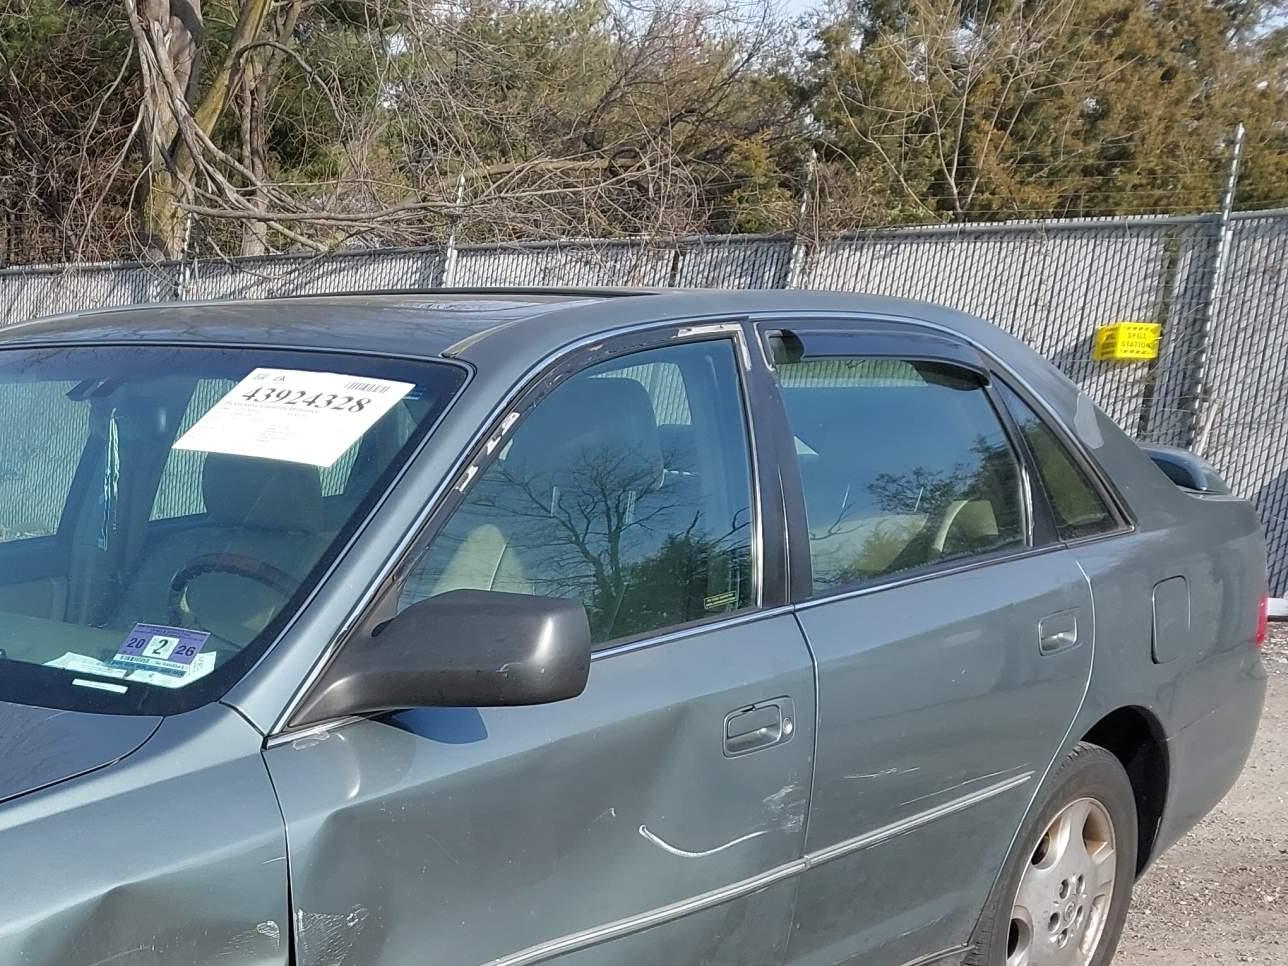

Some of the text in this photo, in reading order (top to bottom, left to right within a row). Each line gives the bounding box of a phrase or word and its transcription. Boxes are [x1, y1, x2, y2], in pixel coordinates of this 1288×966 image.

[1127, 332, 1147, 340] SPILL
[1120, 341, 1152, 349] STATION
[242, 385, 372, 413] 43924328
[126, 637, 196, 657] 20 2 26
